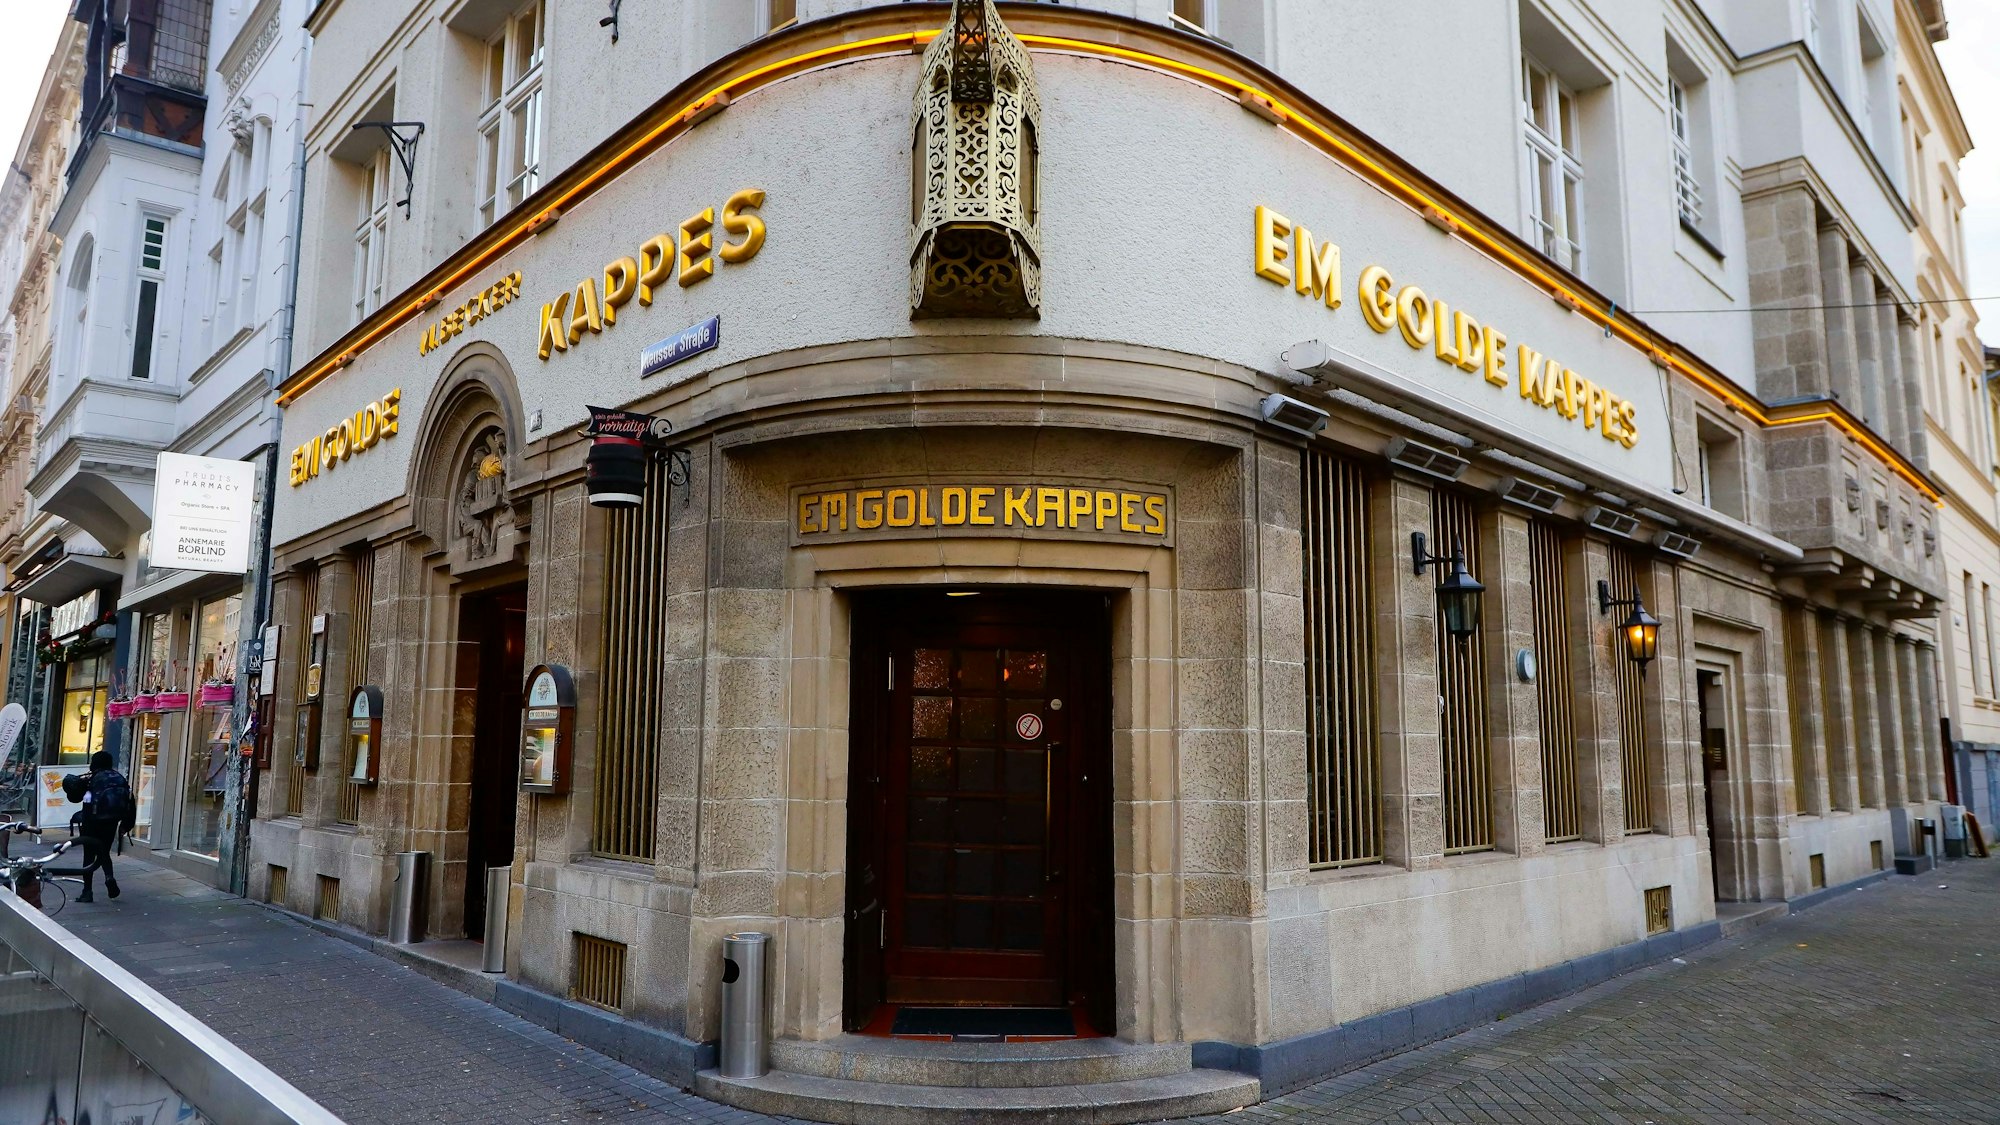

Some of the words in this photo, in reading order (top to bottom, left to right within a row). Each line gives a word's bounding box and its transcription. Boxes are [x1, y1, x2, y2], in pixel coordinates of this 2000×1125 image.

[289, 435, 321, 487] EM
[321, 387, 401, 470] GOLDE
[537, 187, 766, 361] KAPPES
[1255, 205, 1342, 310] EM
[1358, 264, 1509, 387] GOLDE
[1518, 343, 1640, 449] KAPPES
[680, 326, 709, 353] Straße
[599, 418, 652, 439] vorrätig!
[175, 479, 239, 491] PHARMACY
[184, 471, 231, 482] TRUDIS
[800, 492, 848, 534] EM
[856, 487, 996, 529] GOLDE
[1004, 487, 1166, 535] KAPPES
[178, 544, 226, 556] BÖRLIND
[179, 537, 225, 546] ANNEMARIE
